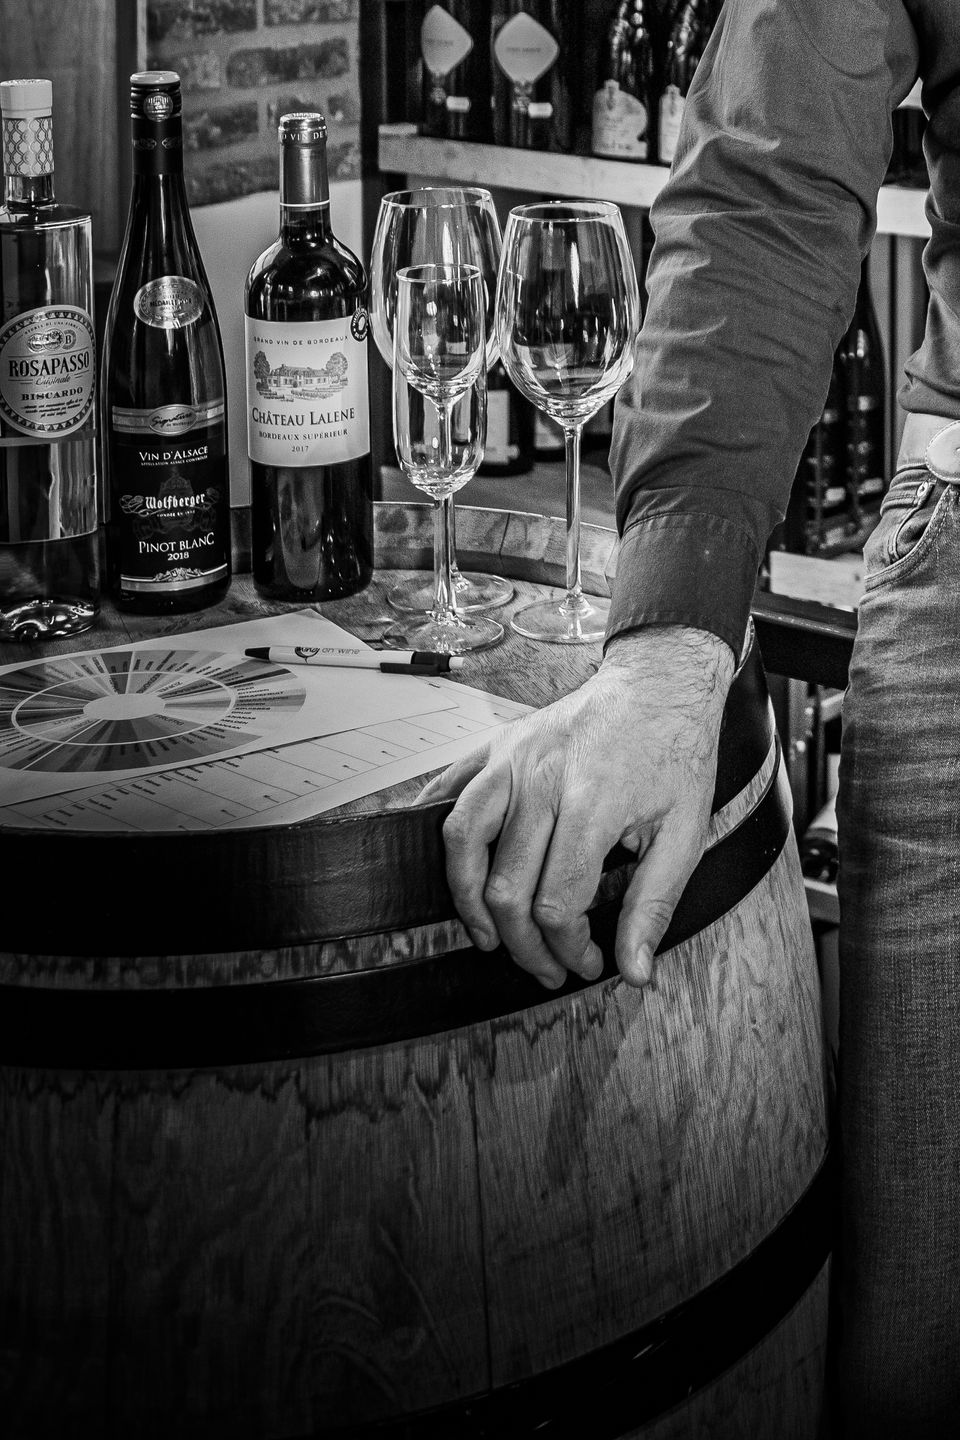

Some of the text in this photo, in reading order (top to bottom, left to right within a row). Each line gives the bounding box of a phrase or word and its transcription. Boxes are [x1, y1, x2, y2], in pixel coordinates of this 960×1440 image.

[254, 336, 273, 345] GRAND
[307, 336, 348, 345] BORDEAUX
[8, 350, 90, 378] ROSAPASSO
[21, 386, 83, 401] BISCARDO
[252, 407, 305, 426] CHÂTEAU
[259, 430, 300, 441] BORDEAUX
[291, 445, 309, 453] 2017
[139, 451, 160, 461] VIN
[145, 493, 205, 510] Wolfberger
[139, 532, 215, 554] PINOT BLANC
[167, 551, 190, 561] 2018
